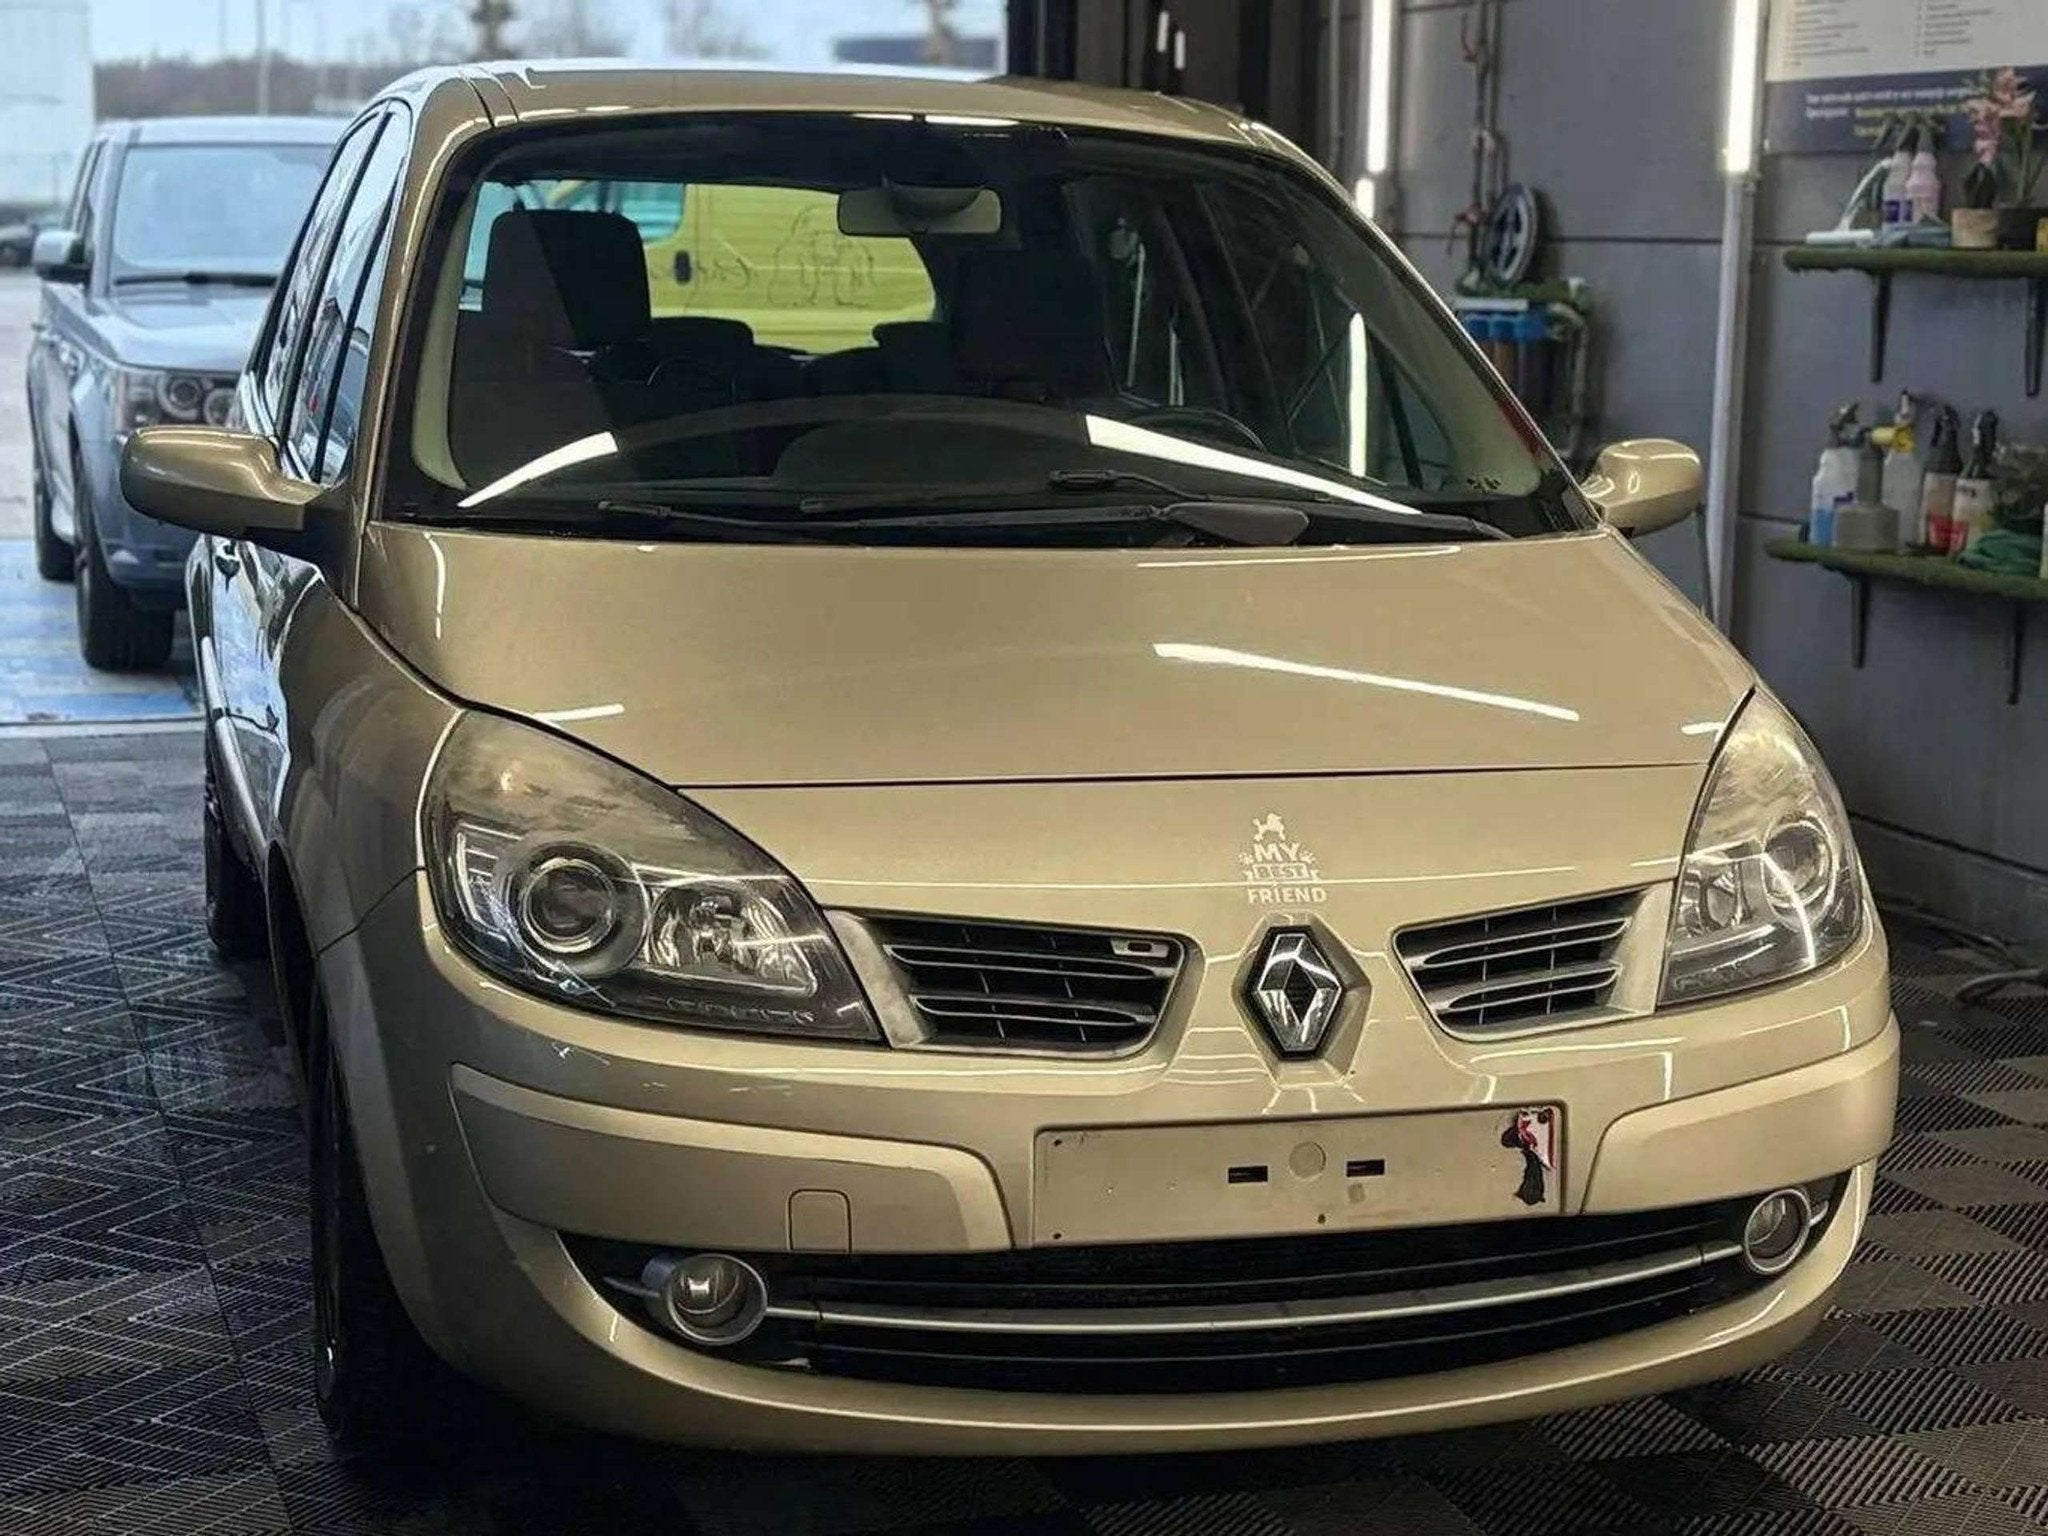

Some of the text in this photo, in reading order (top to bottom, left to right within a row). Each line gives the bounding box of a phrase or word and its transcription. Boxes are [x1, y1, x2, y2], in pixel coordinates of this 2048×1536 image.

[1253, 843, 1300, 862] MY
[1254, 865, 1307, 880] BEST
[1247, 887, 1327, 904] FRIEND
